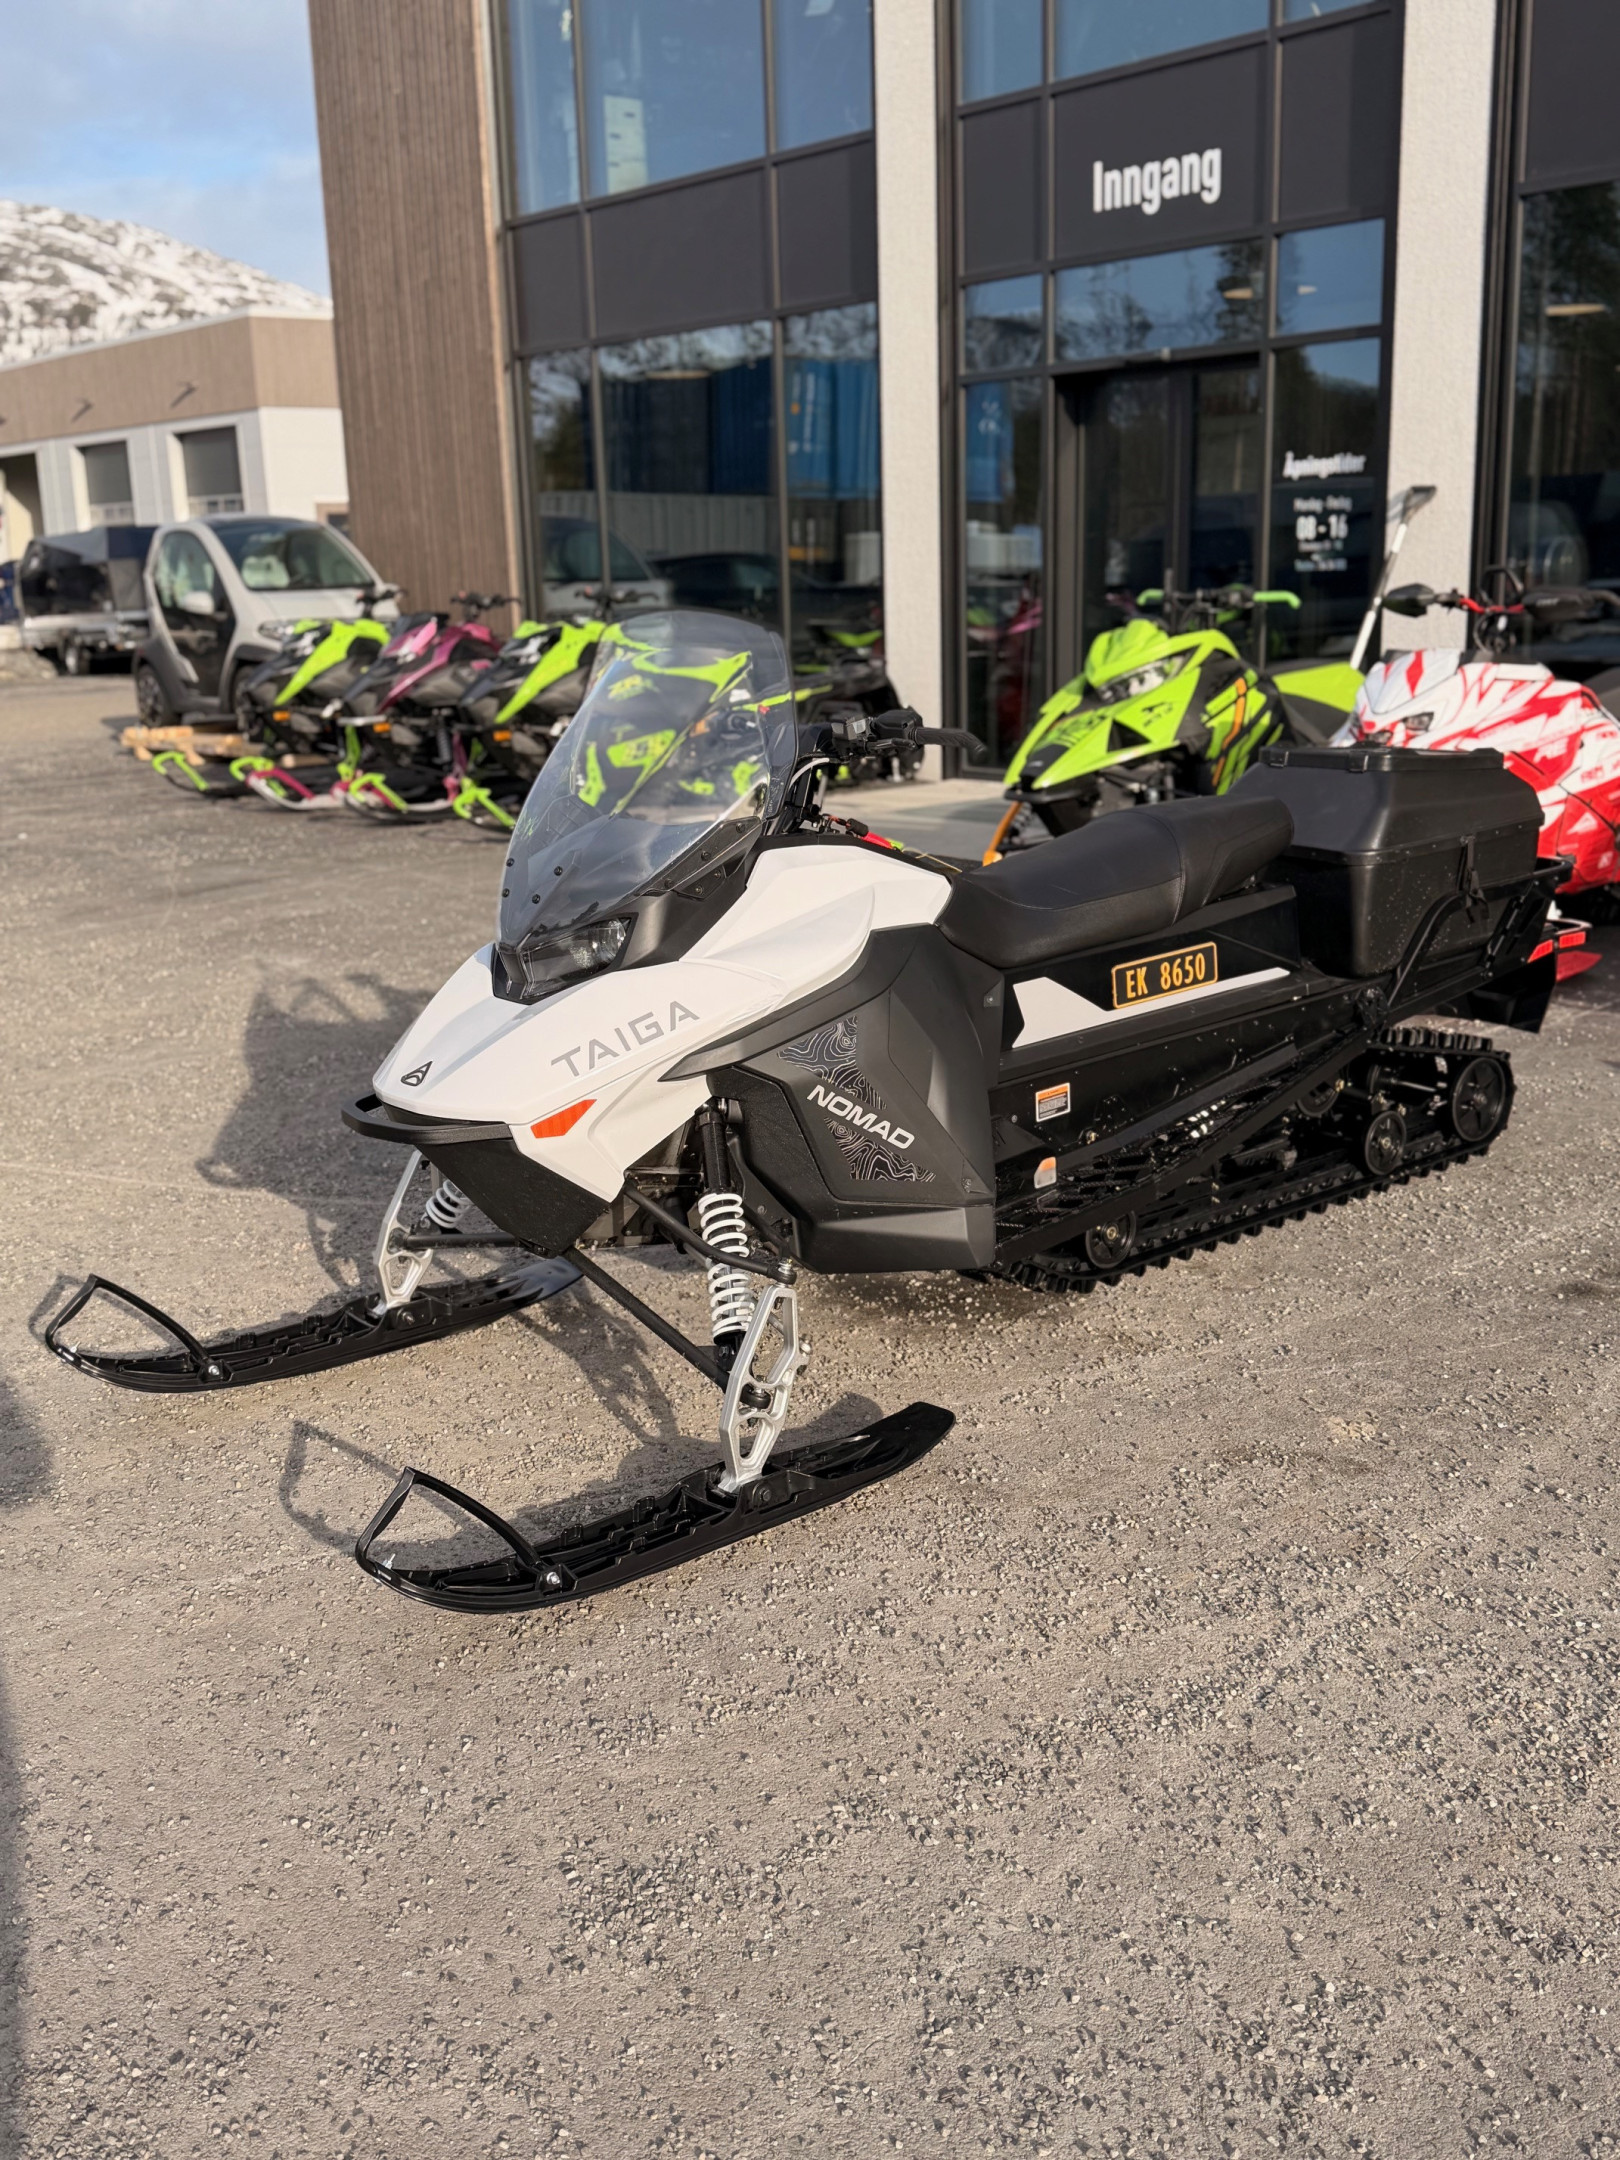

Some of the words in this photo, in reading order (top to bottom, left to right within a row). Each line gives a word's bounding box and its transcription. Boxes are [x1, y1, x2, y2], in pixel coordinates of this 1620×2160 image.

[1093, 147, 1222, 215] Inngang
[1125, 966, 1149, 999] EK
[1160, 952, 1206, 991] 8650
[550, 1000, 701, 1078] TAIGA
[806, 1084, 916, 1150] NOMAD
